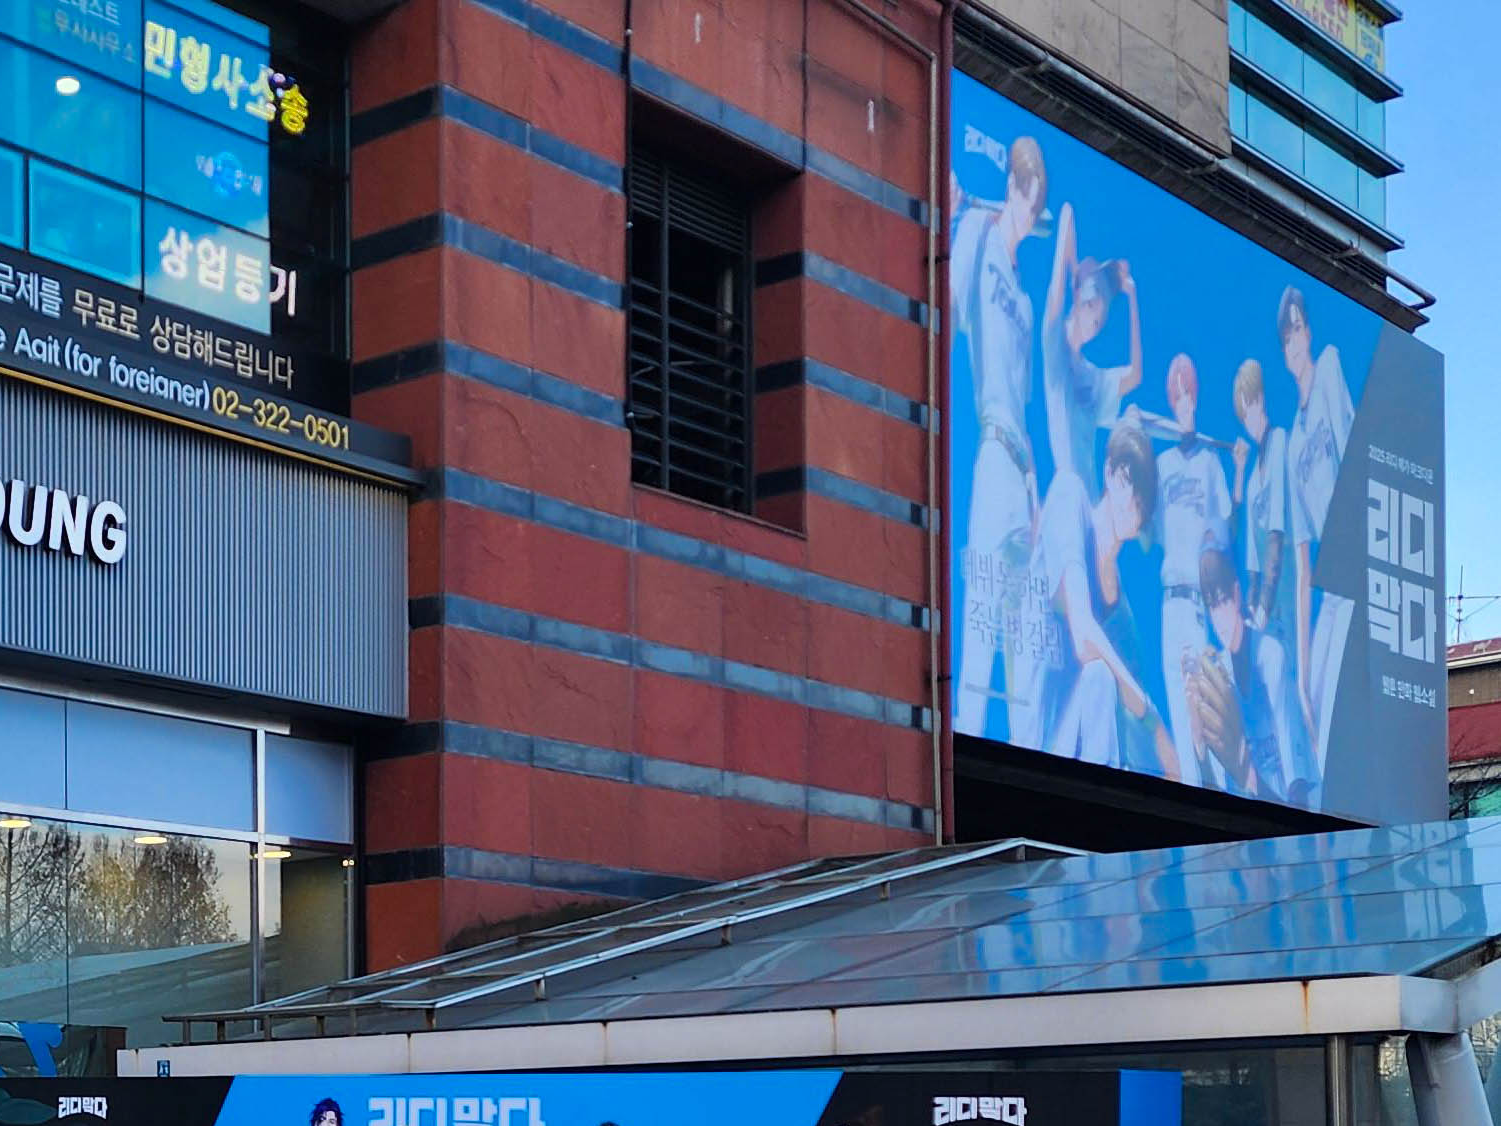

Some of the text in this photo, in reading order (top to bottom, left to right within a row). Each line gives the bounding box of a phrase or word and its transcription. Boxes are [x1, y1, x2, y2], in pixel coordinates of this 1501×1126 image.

[158, 225, 298, 318] 상업등기
[71, 288, 141, 344] 무료로
[149, 313, 297, 390] 상담해드립니다
[65, 333, 106, 378] (for
[211, 384, 352, 452] 02-322-0501
[1366, 477, 1435, 579] 리디
